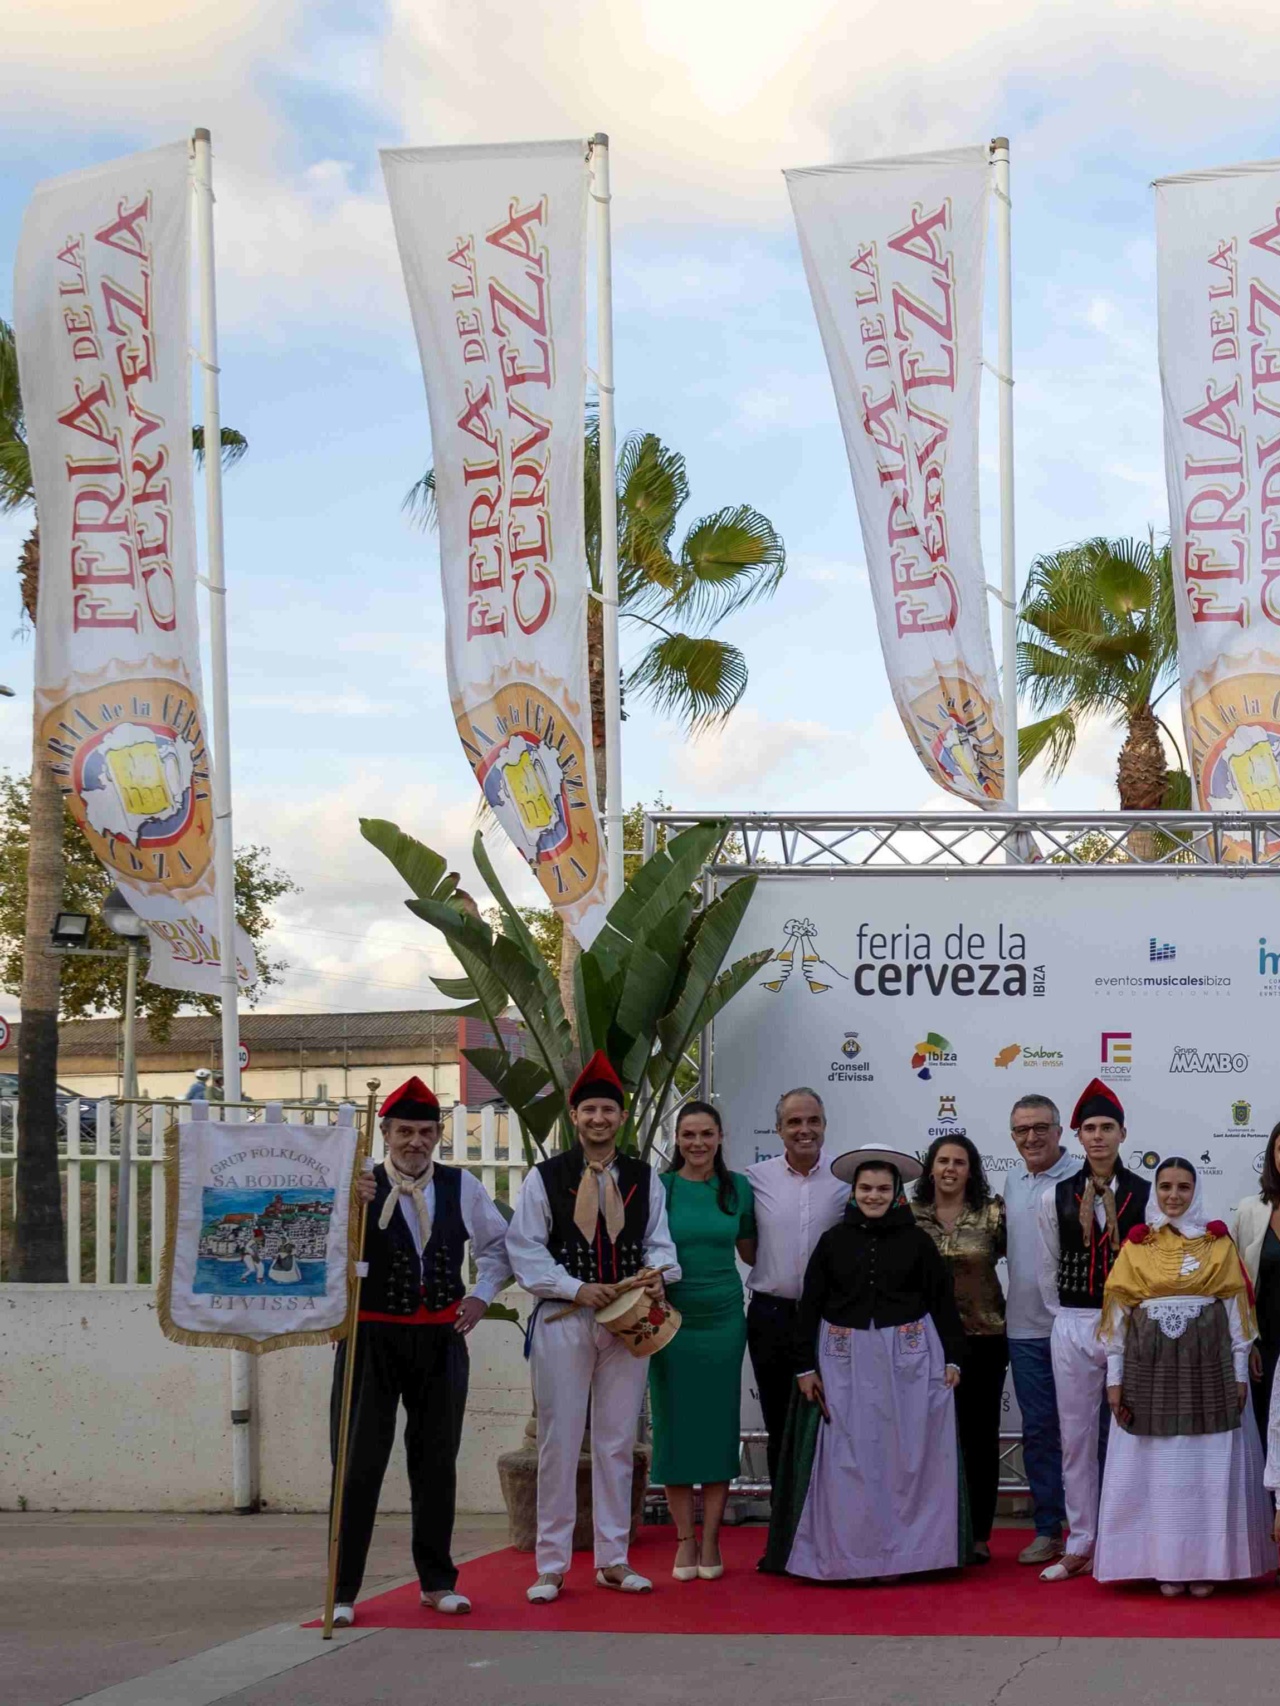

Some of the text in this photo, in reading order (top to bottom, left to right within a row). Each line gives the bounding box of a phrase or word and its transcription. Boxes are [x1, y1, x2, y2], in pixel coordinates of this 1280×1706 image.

[94, 188, 178, 633] CERVEZA
[485, 195, 557, 636] CERVEZA
[56, 232, 143, 636] FERIA DE LA
[447, 234, 508, 642] FERIA DE LA
[848, 240, 953, 640] FERIA DE LA
[1183, 236, 1250, 630] FERIA DE LA
[856, 922, 1027, 962] feria de la
[853, 961, 1028, 998] cerveza
[1033, 964, 1048, 998] IBIZA
[1094, 975, 1232, 987] eventosmusicalesibiza
[830, 1062, 870, 1072] Consell
[1022, 1045, 1064, 1059] Sabors
[1169, 1053, 1249, 1073] MAMBO
[1173, 1046, 1198, 1054] Grupo
[210, 1147, 331, 1176] GRUP FOLKLORIC
[213, 1174, 329, 1188] SA BODEGA
[209, 1294, 317, 1311] EIVISSA
